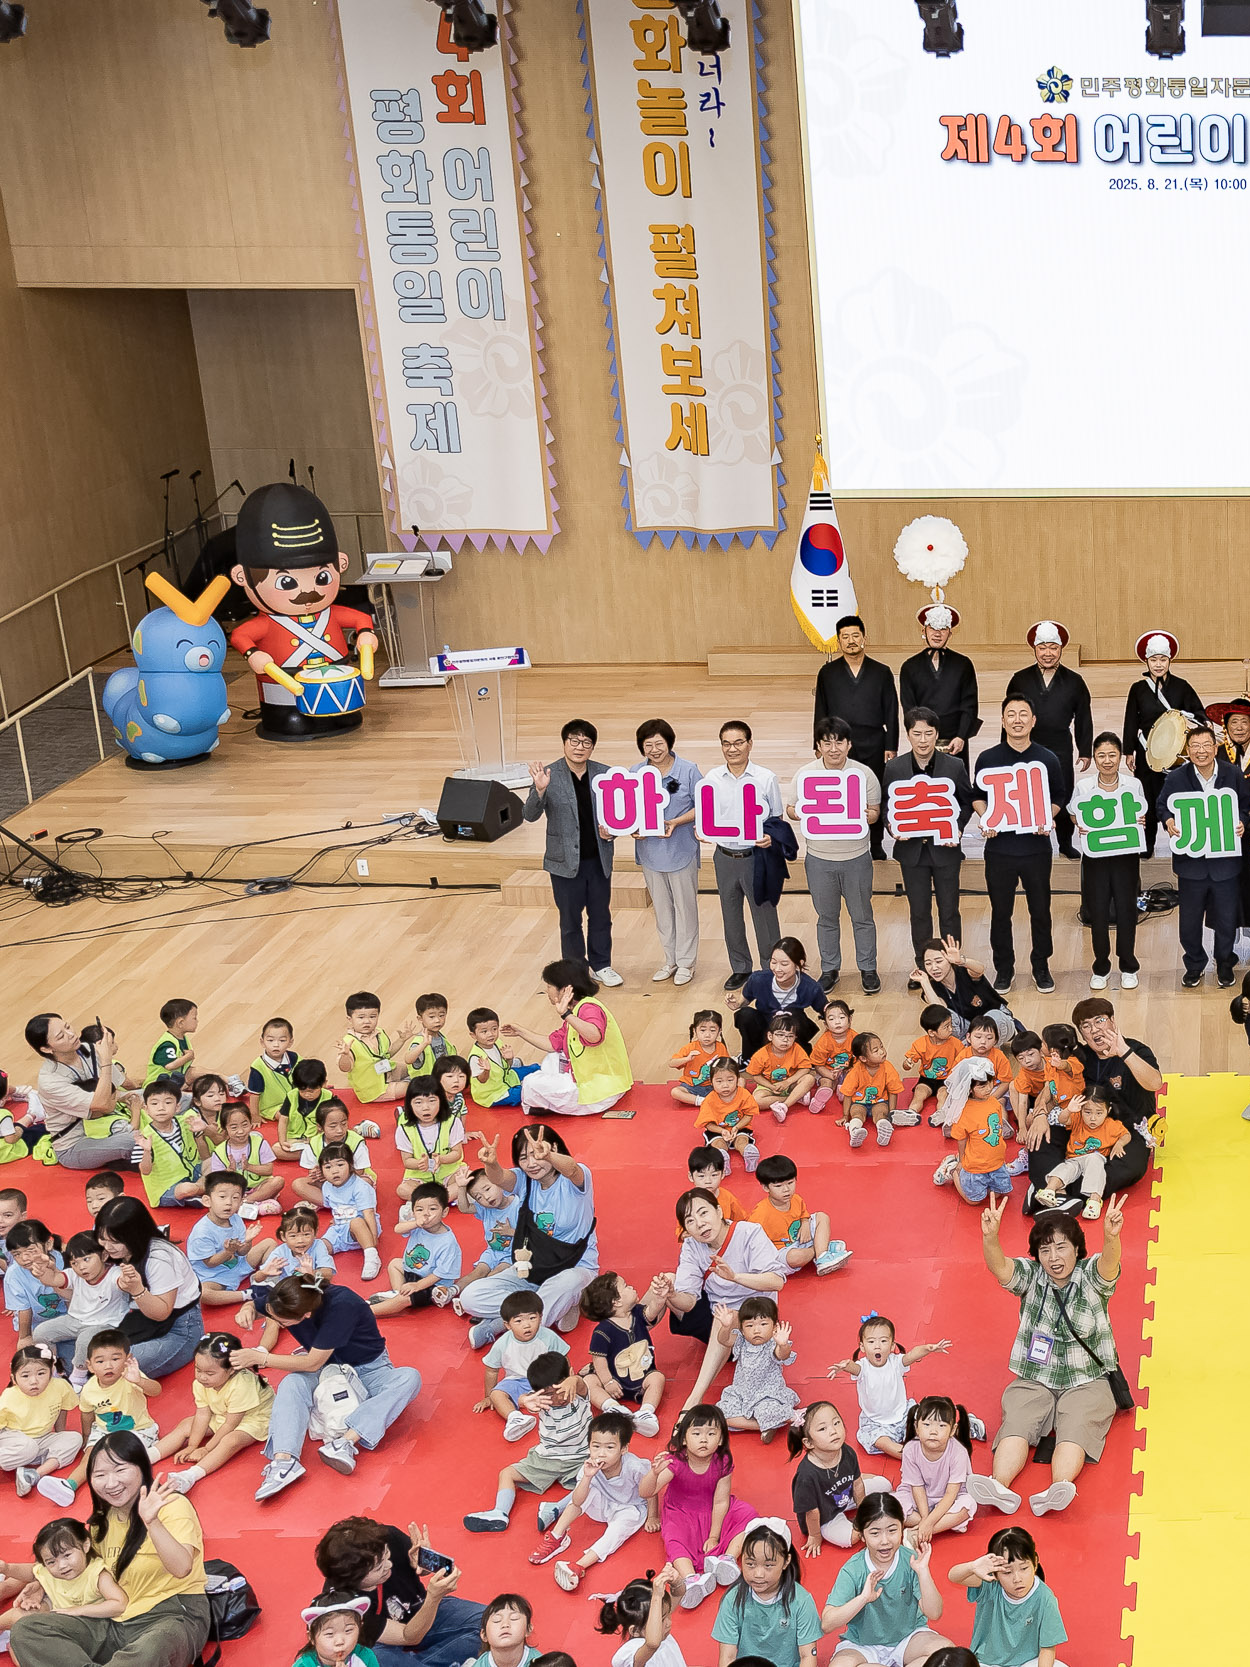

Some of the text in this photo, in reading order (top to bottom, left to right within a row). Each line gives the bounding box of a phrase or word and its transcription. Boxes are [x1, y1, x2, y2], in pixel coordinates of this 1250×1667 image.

[939, 113, 1079, 165] 제4회
[1094, 113, 1245, 166] 어린이
[1108, 178, 1142, 191] 2025.
[1147, 178, 1159, 191] 8.
[1214, 178, 1248, 190] 10:00
[443, 147, 506, 321] 어린이
[629, 0, 710, 457] 화놀이 펼쳐보세
[370, 88, 462, 454] 평화통일 축제
[598, 771, 862, 841] 하나된
[894, 768, 1046, 839] 축제
[1077, 791, 1236, 852] 함께
[165, 1047, 177, 1059] 3
